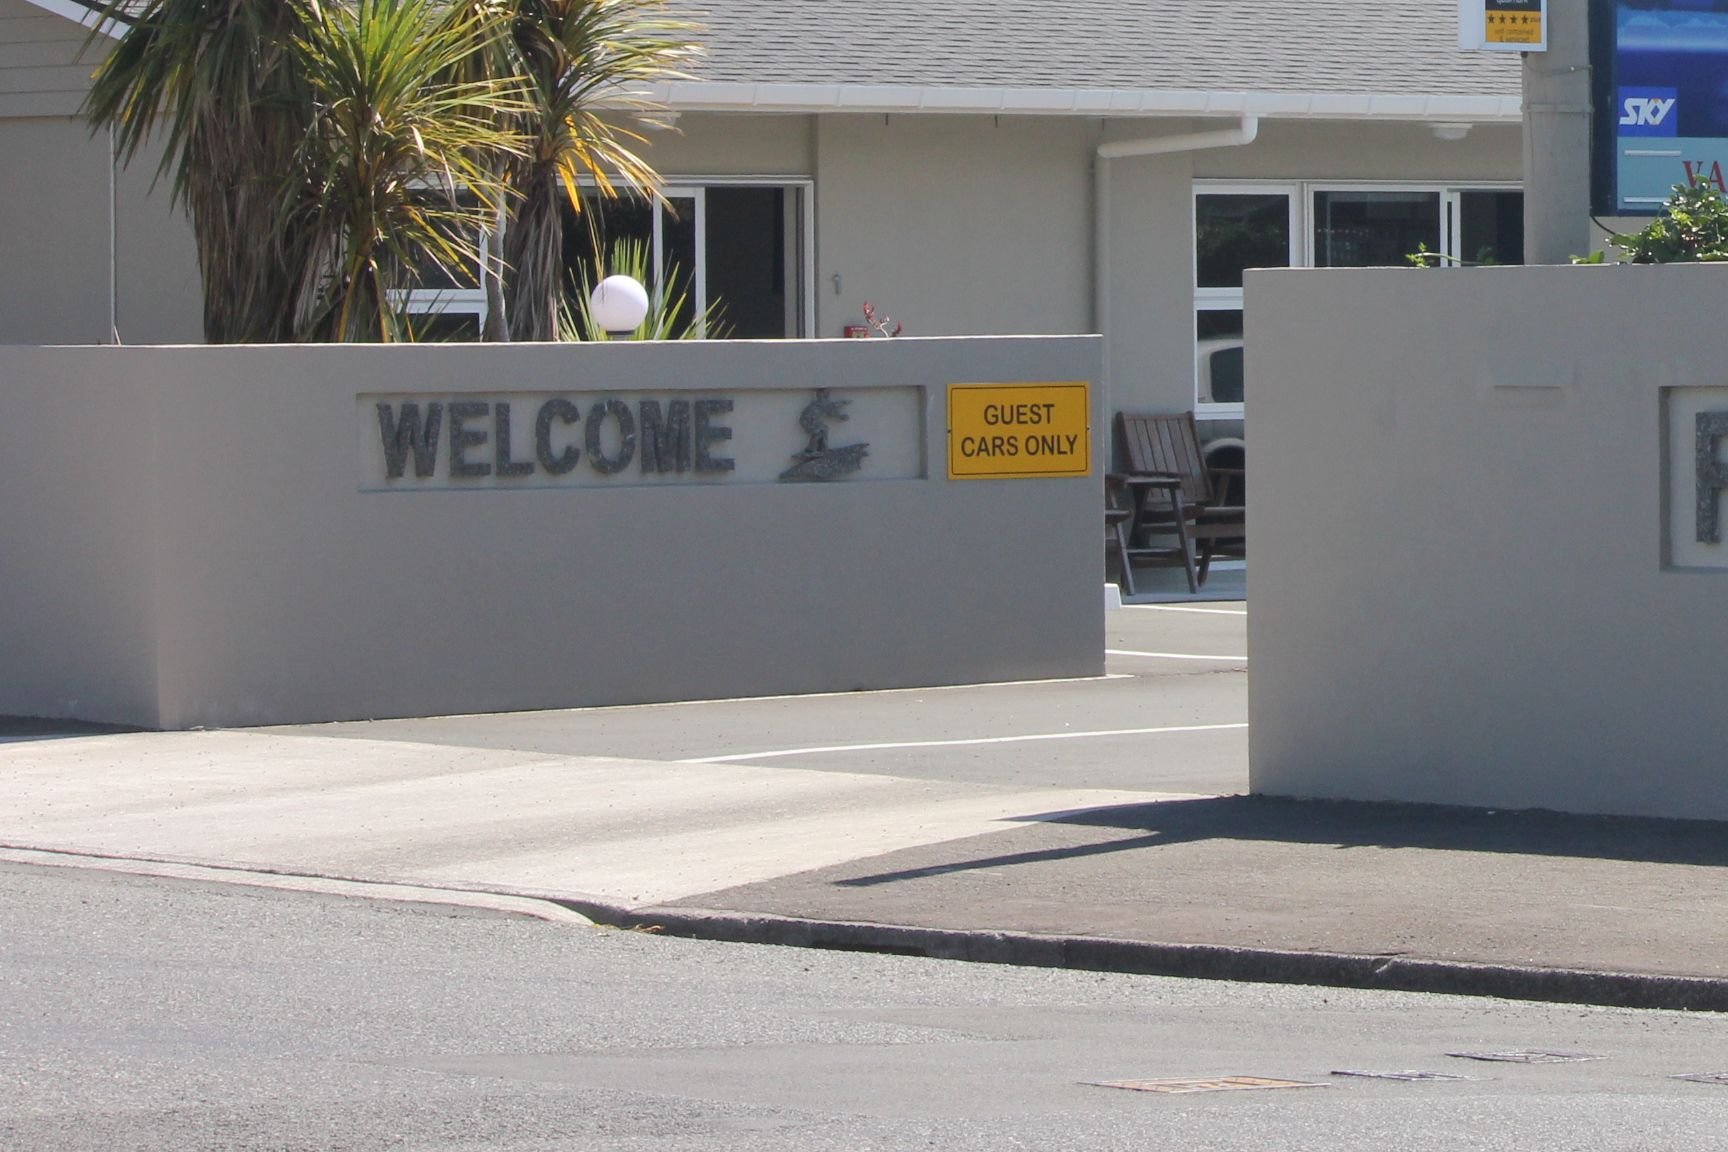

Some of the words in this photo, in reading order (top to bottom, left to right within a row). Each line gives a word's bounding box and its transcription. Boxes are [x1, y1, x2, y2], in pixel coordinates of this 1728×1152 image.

[1619, 97, 1676, 126] SKY
[984, 403, 1055, 426] GUEST
[375, 398, 736, 479] WELCOME
[960, 435, 1019, 458] CARS
[1025, 434, 1078, 456] ONLY
